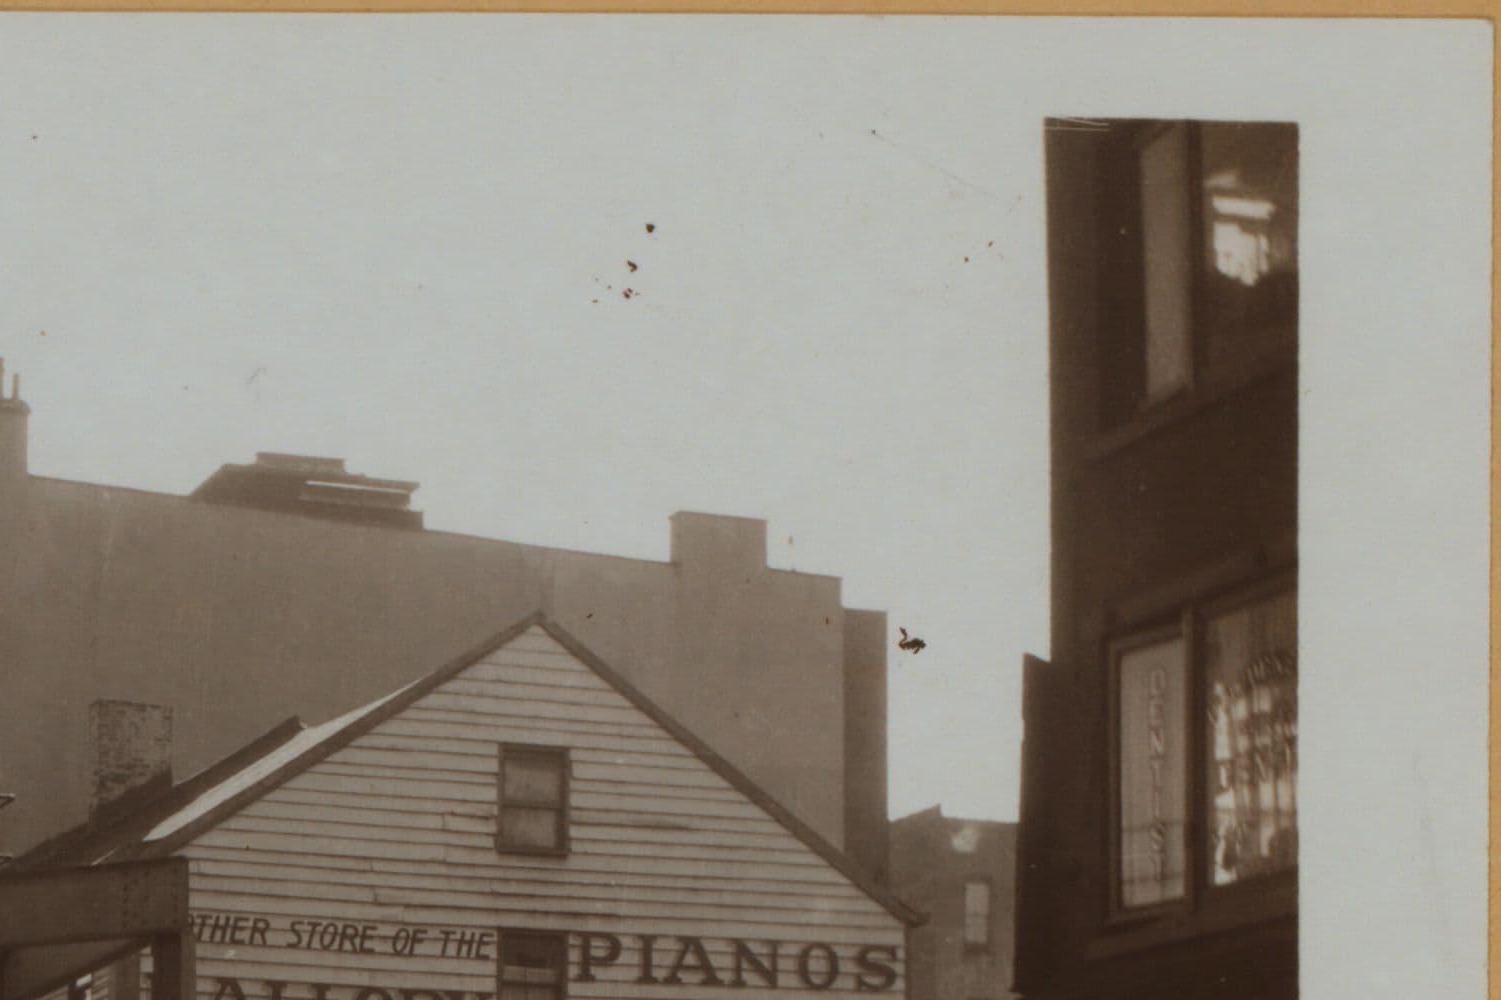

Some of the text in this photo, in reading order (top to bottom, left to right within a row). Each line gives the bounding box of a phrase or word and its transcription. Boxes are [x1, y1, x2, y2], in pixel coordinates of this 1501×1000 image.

[286, 920, 376, 954] STORE
[392, 925, 431, 957] OF
[440, 929, 495, 961] THE
[571, 932, 899, 992] PIANOS
